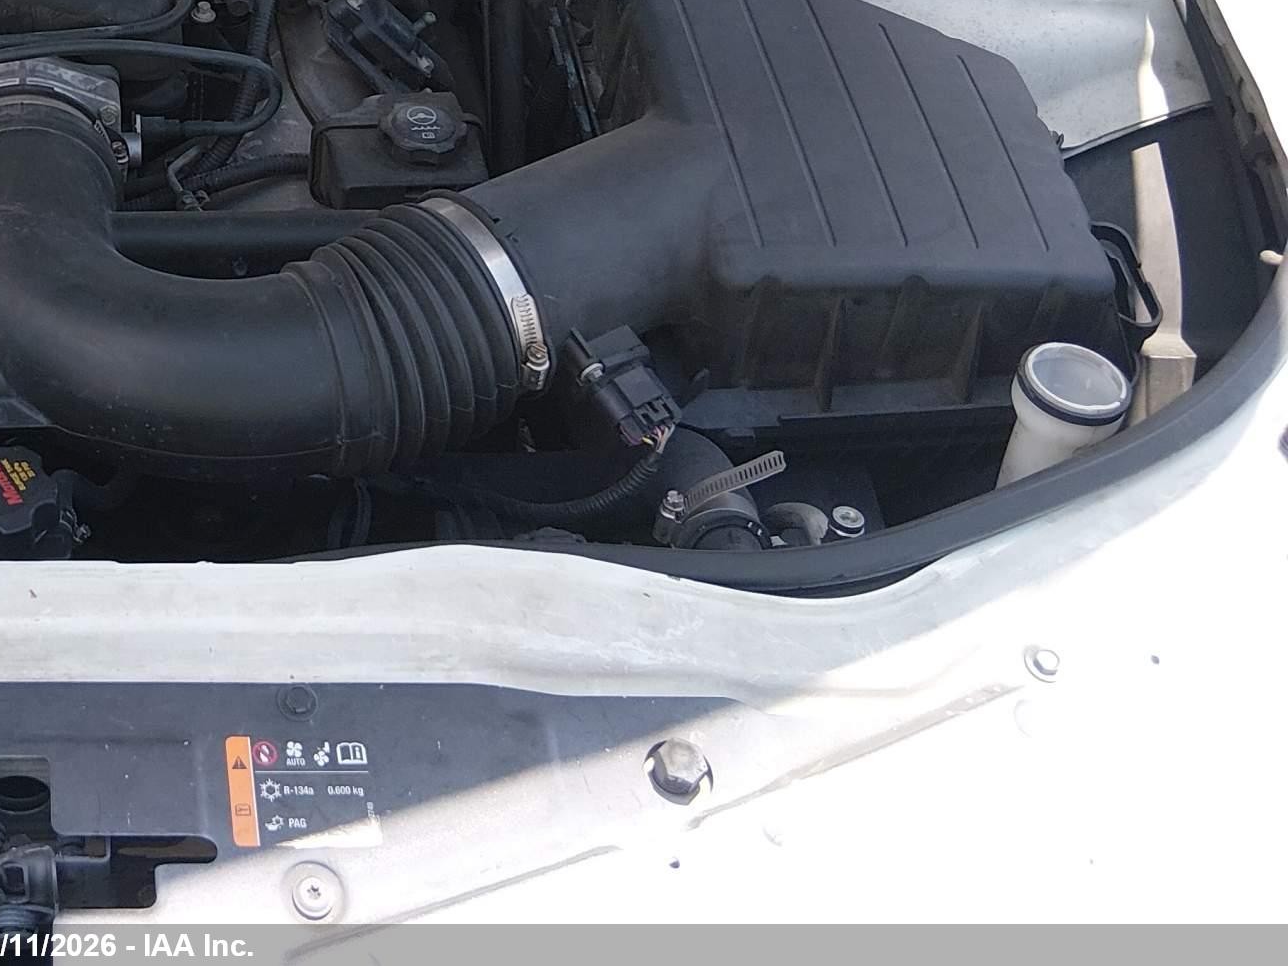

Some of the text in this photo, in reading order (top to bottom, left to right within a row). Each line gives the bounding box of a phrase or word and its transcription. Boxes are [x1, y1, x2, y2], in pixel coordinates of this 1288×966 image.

[286, 757, 306, 766] AUTO
[283, 786, 364, 797] R-134a 0.600 kg
[288, 818, 307, 828] PAG
